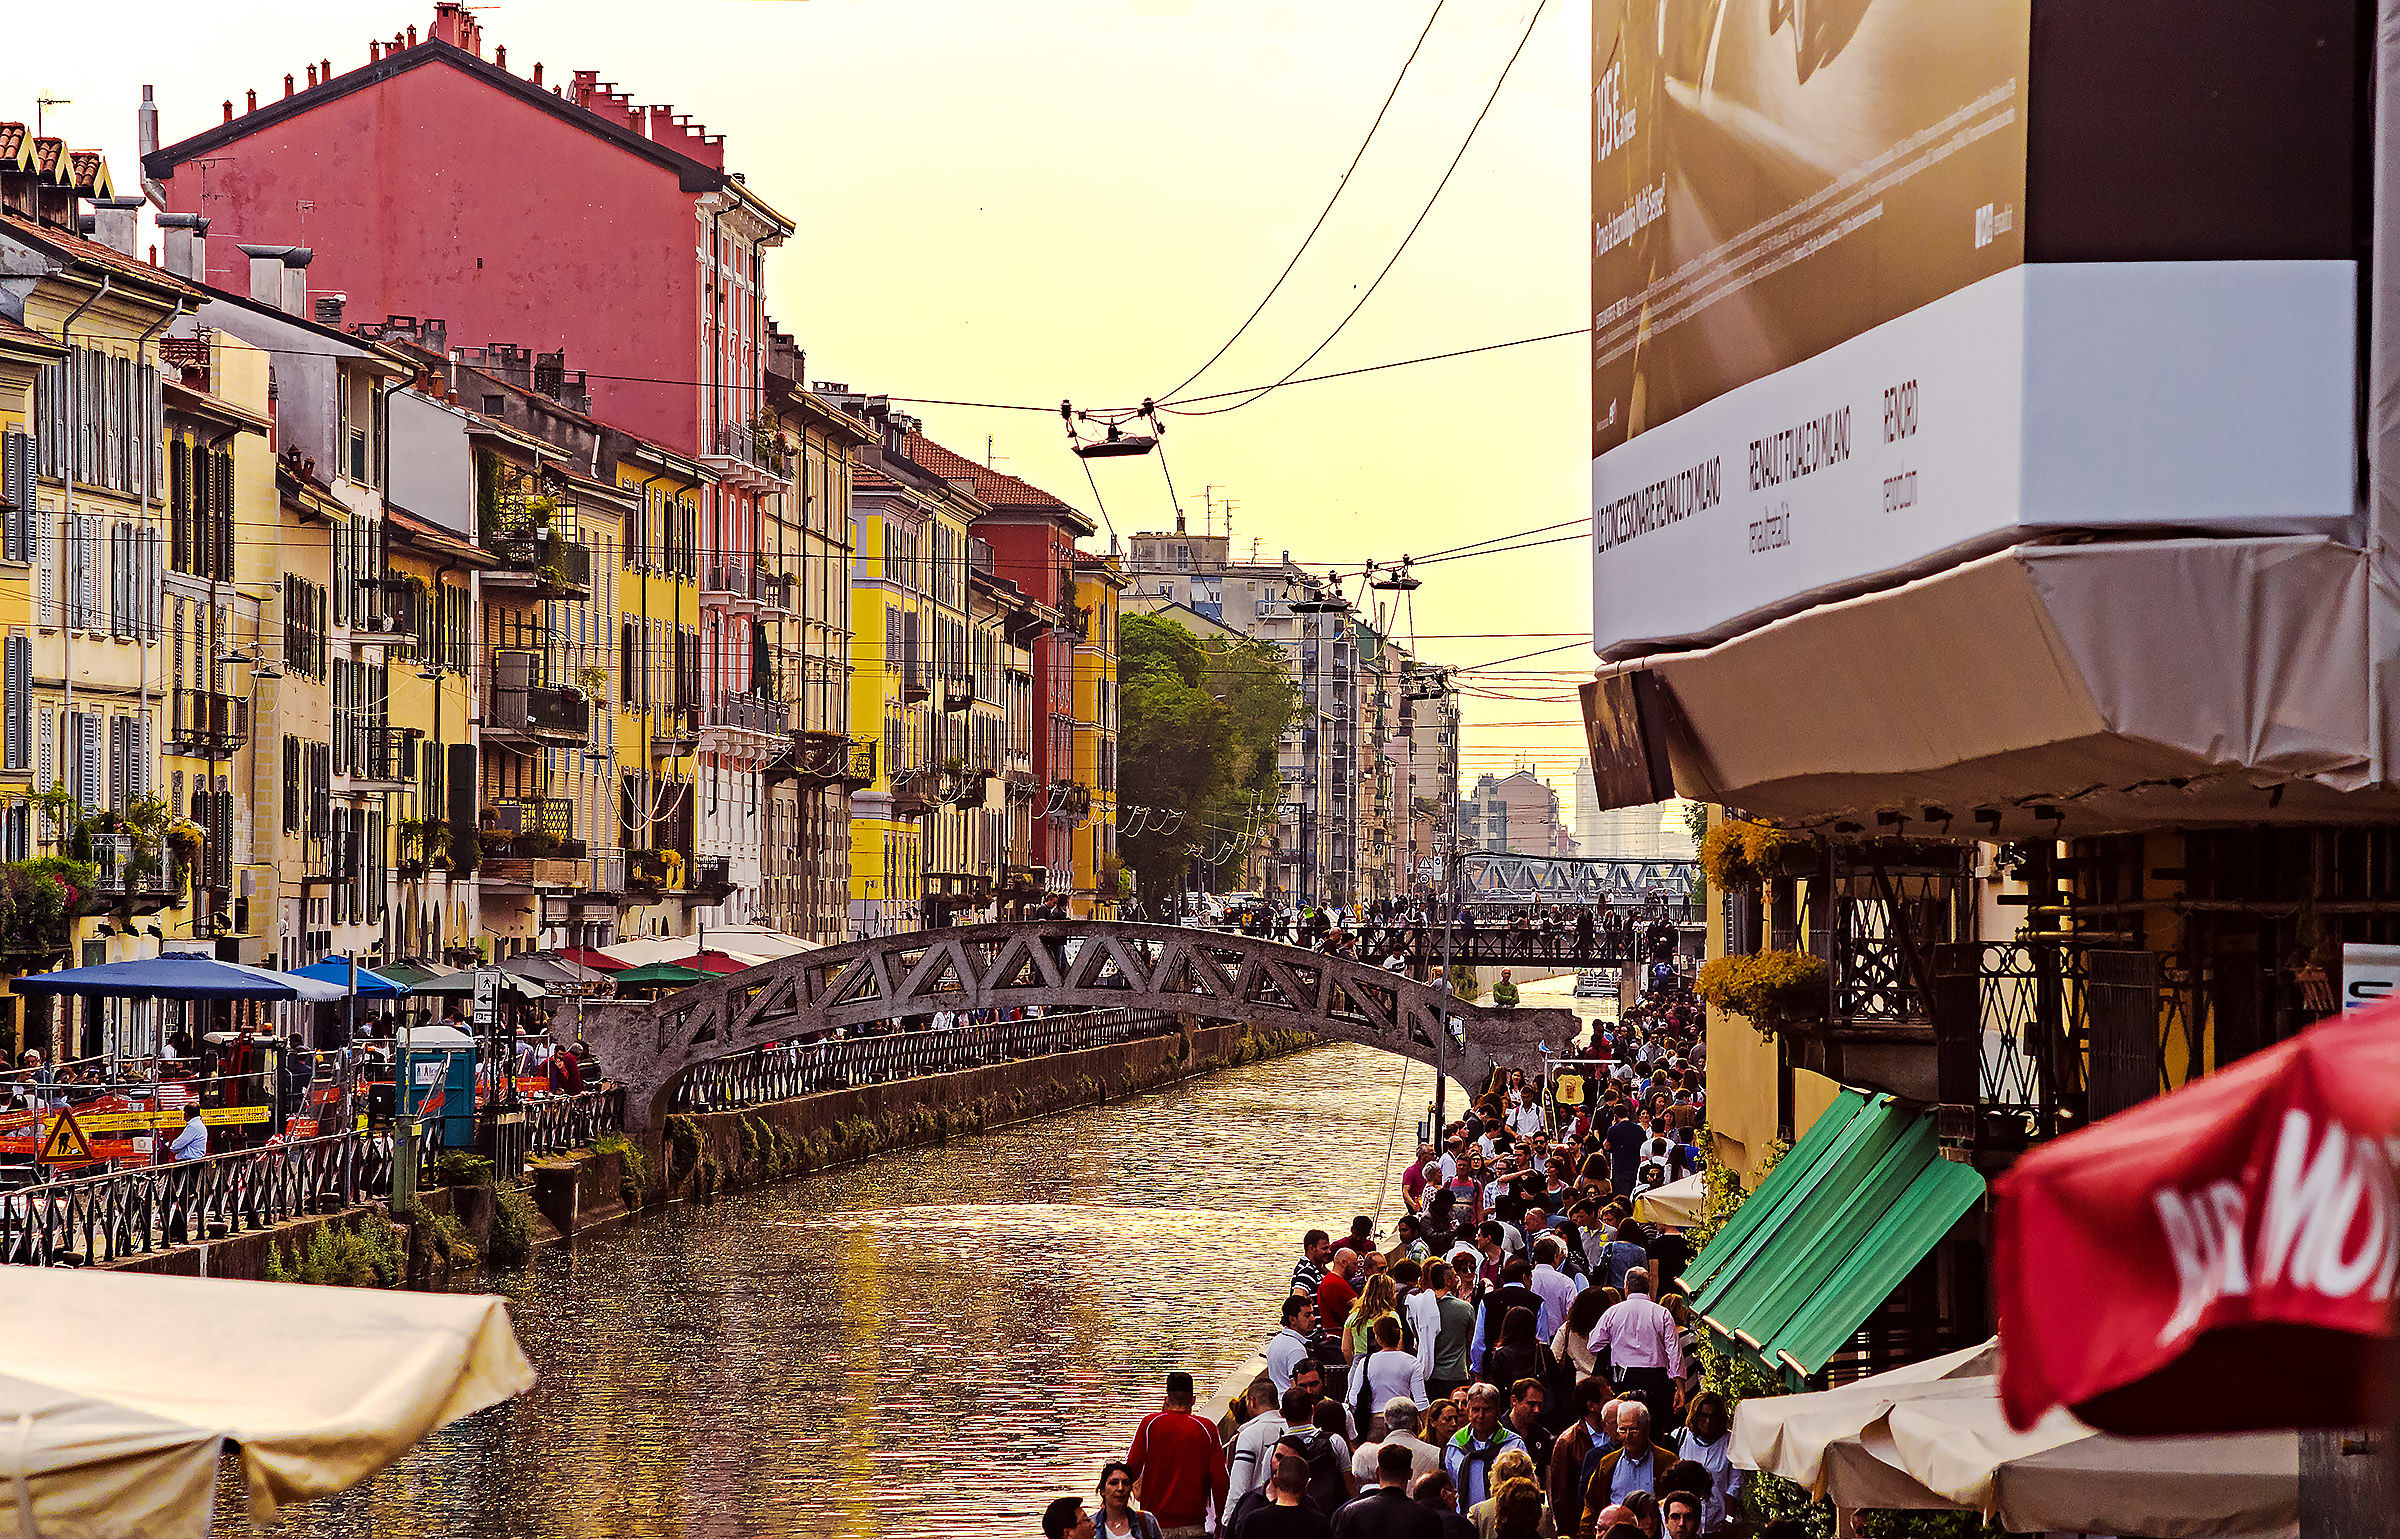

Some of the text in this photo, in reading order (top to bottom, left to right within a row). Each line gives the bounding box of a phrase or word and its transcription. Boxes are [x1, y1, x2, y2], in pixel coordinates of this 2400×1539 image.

[1749, 432, 1783, 492] RENAULT
[1785, 421, 1811, 481] FILIALE
[1821, 405, 1851, 469] MILANO
[1884, 379, 1919, 444] RENORD
[1597, 507, 1605, 554] LE
[1605, 484, 1655, 551] CONCESSIONARIE
[1656, 471, 1685, 527] RENAULT
[1694, 455, 1721, 514] MILANO
